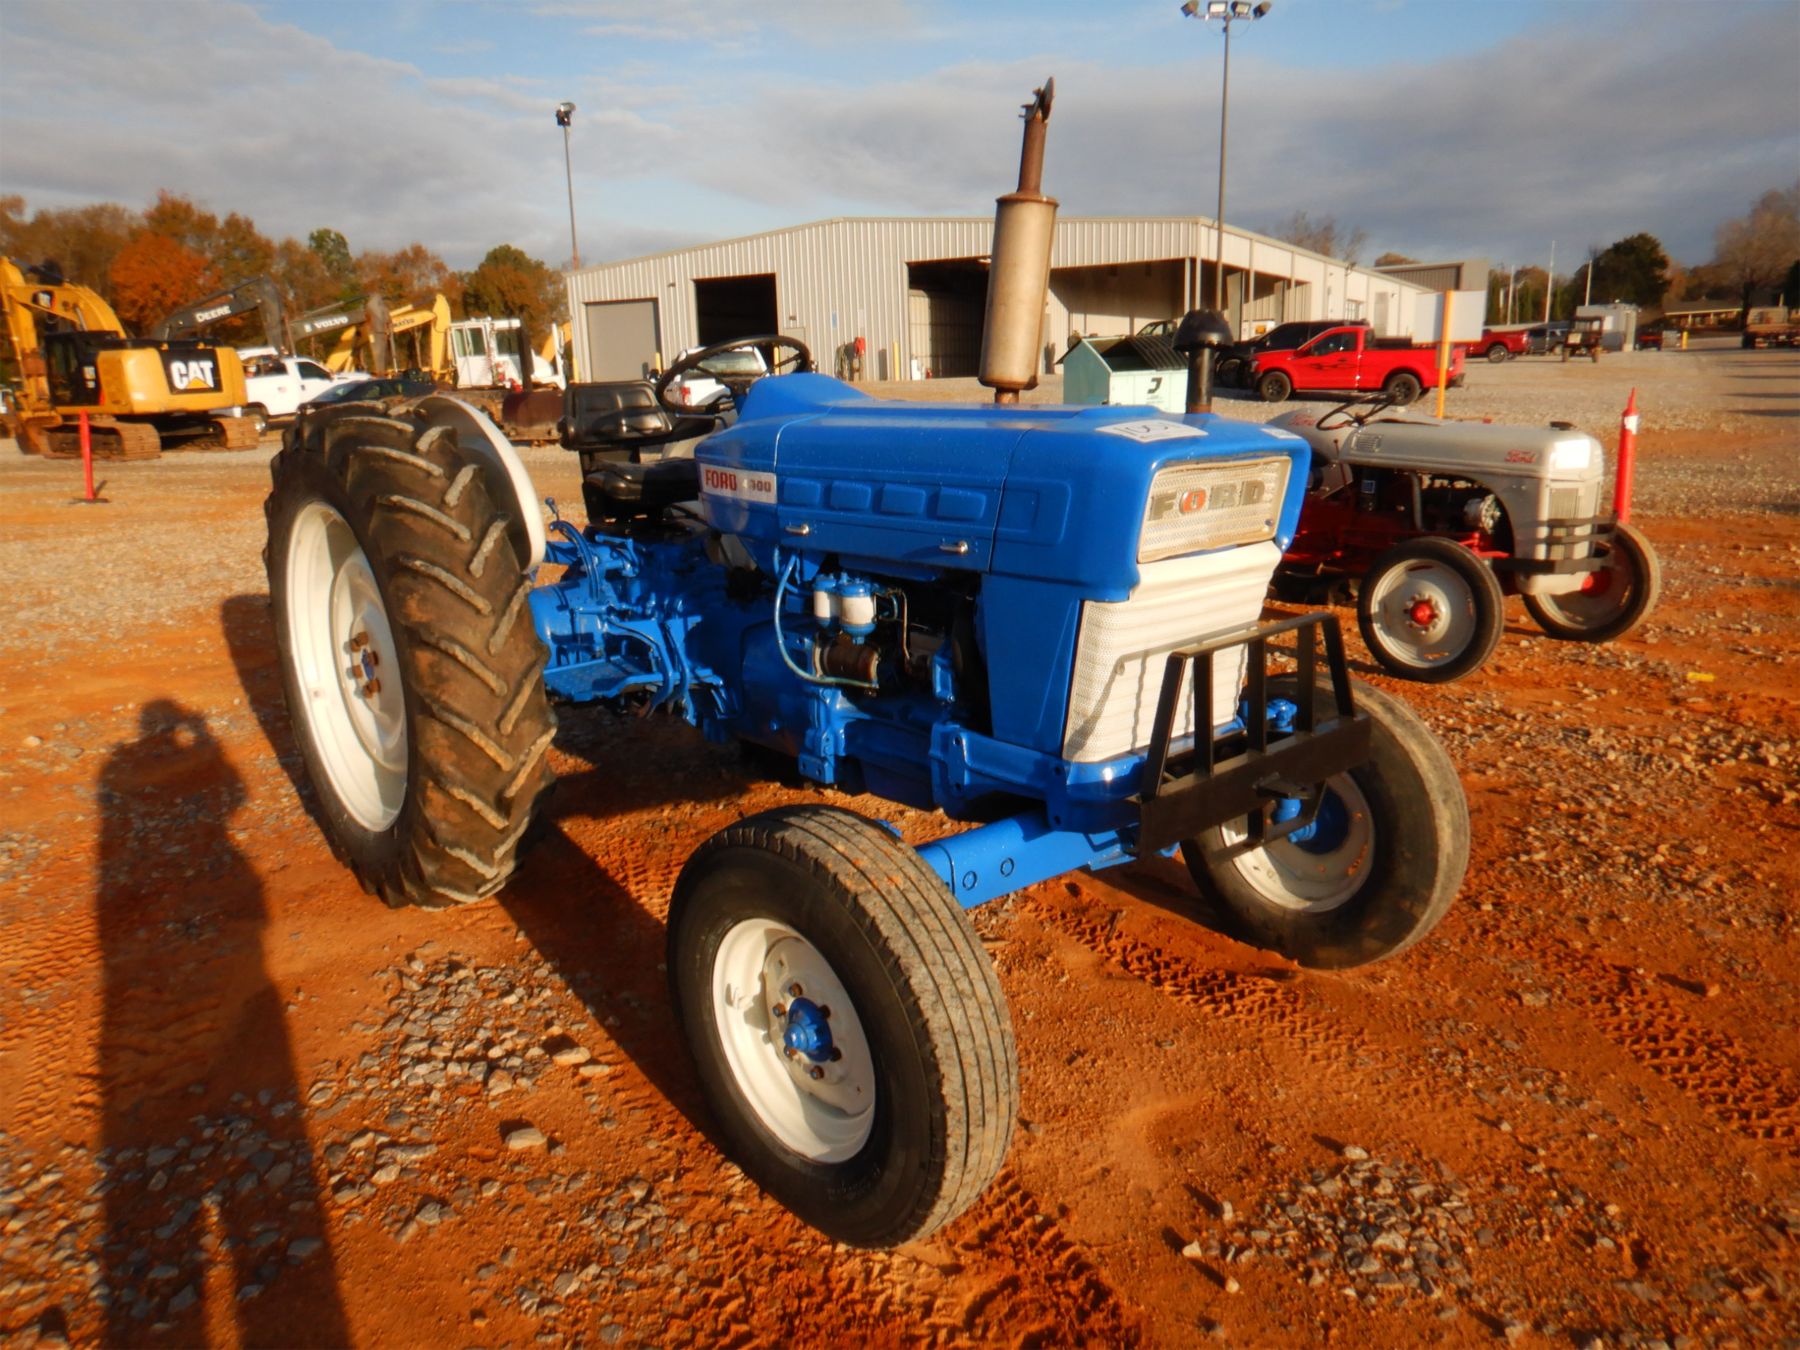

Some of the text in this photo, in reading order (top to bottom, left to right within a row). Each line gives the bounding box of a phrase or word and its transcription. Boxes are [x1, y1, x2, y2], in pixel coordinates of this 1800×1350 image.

[195, 306, 231, 322] DEERE
[314, 316, 348, 328] VOLVO
[170, 361, 214, 389] CAT
[704, 469, 737, 491] FORD
[1148, 480, 1265, 521] FORD
